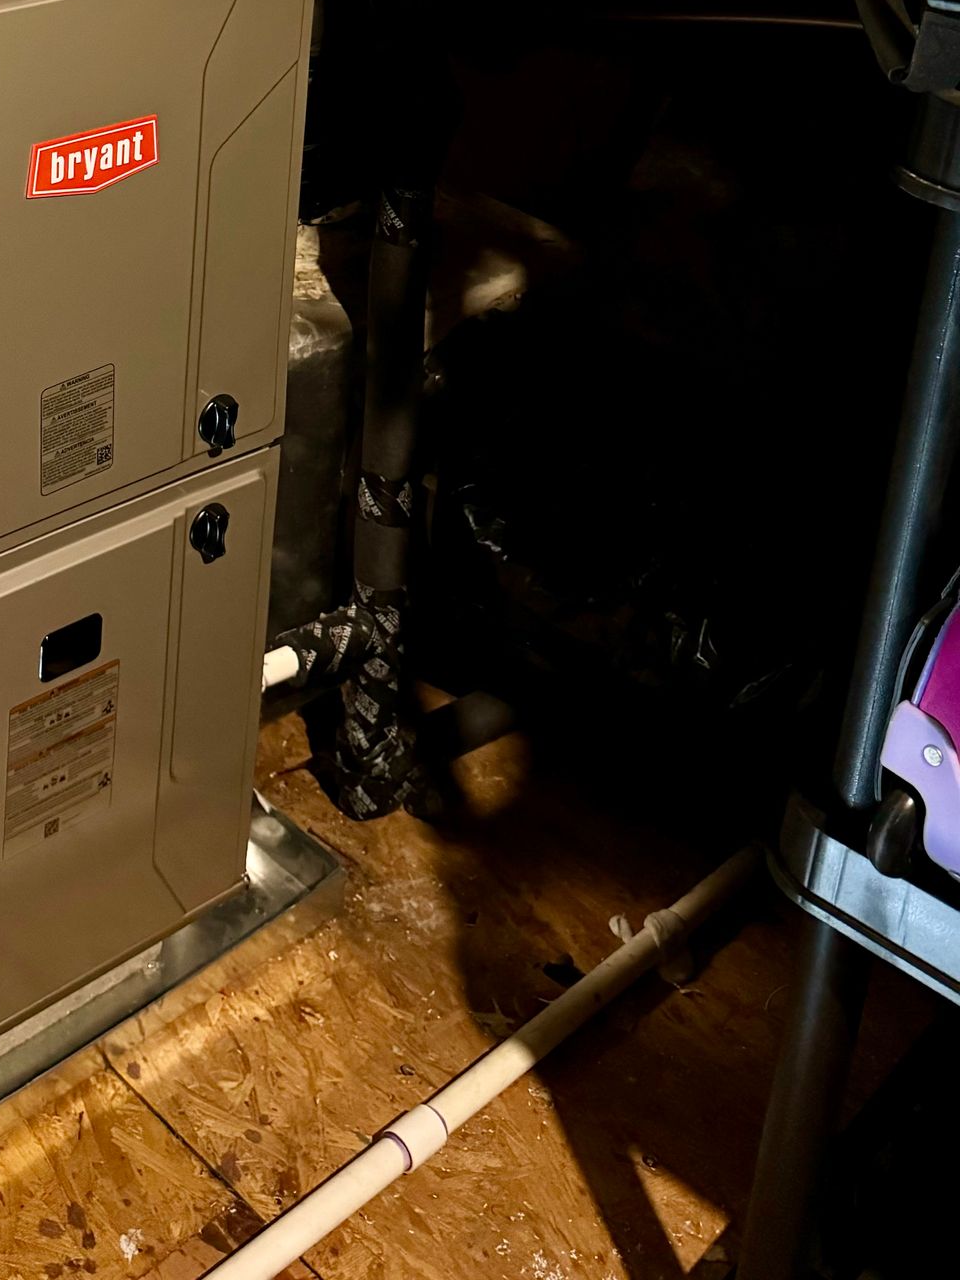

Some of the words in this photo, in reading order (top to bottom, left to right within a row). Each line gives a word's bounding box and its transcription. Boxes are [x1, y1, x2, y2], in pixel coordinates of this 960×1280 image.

[50, 130, 143, 185] bryant
[66, 374, 90, 387] WARNING
[57, 400, 97, 421] AVERTISSEMENT
[60, 437, 95, 456] ADVERTENCIA
